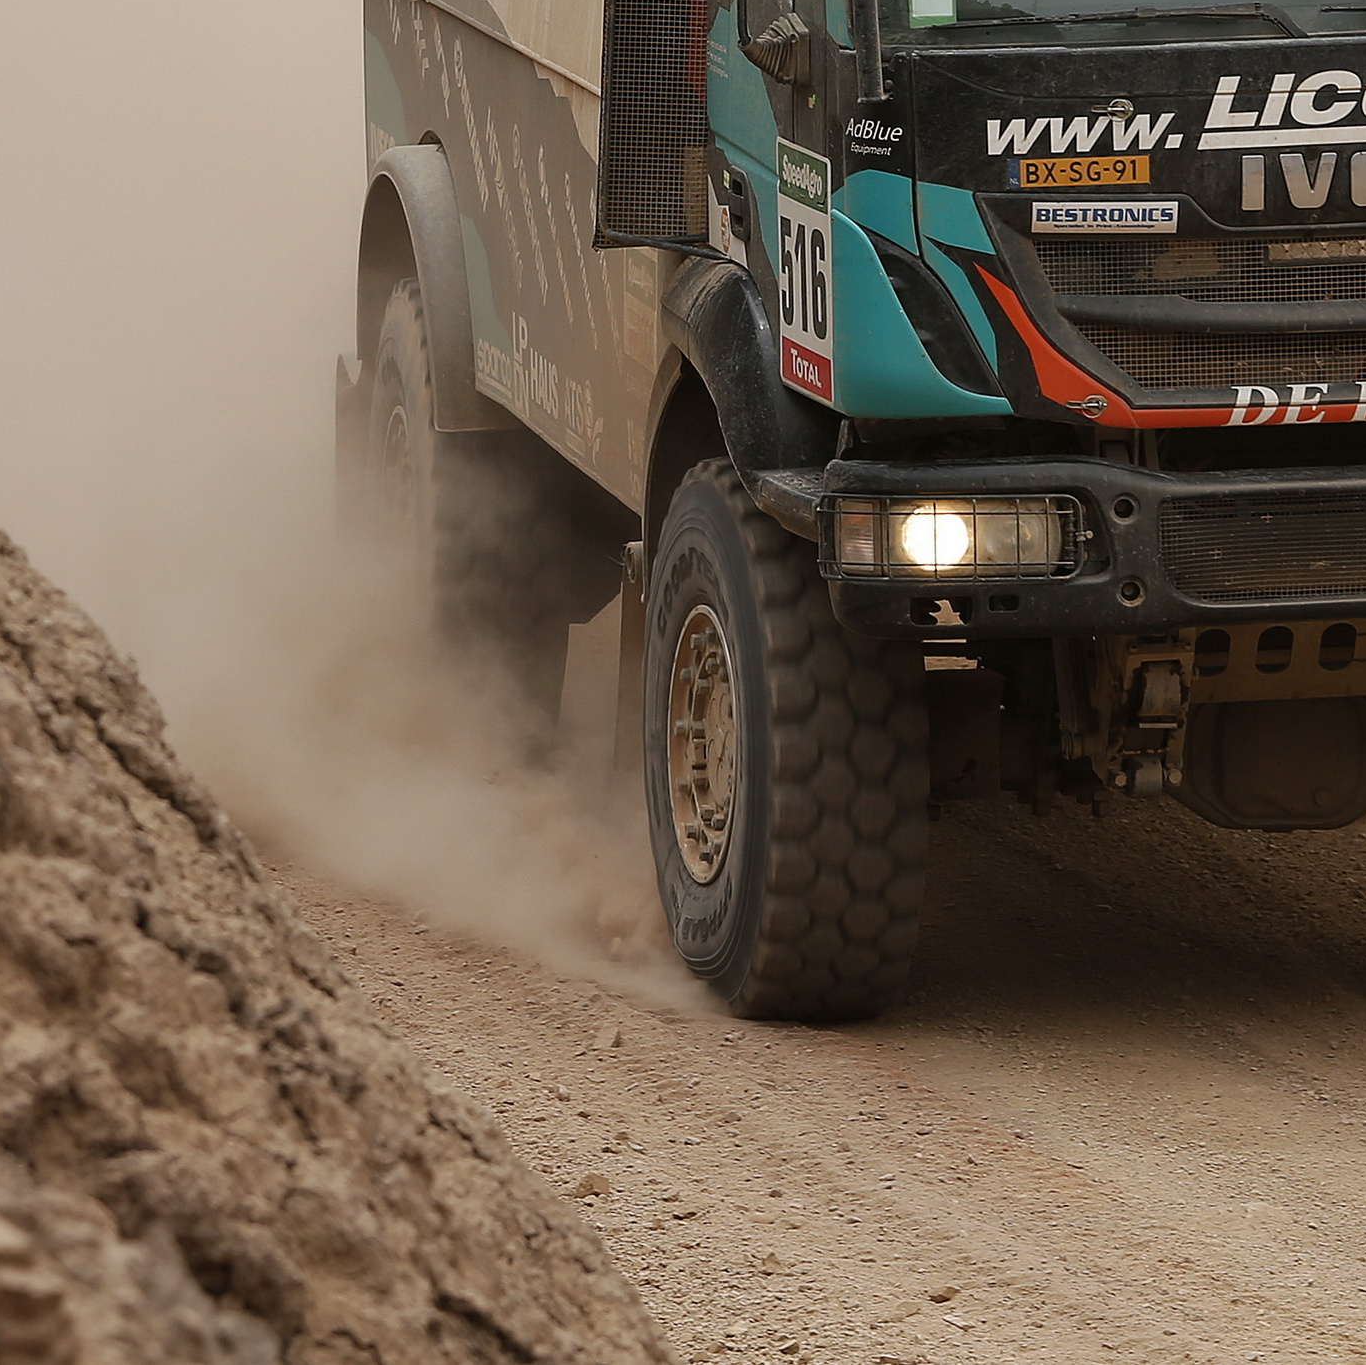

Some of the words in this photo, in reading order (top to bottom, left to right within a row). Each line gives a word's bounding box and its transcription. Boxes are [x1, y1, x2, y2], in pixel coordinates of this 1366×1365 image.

[845, 117, 903, 143] AdBlue
[850, 141, 892, 156] Equipment
[781, 153, 824, 200] SpeedAgro
[1025, 159, 1138, 184] BX-SG-91
[1036, 207, 1174, 222] BESTRONICS
[779, 215, 827, 340] 516
[790, 347, 823, 388] TOTAL
[1223, 382, 1328, 428] DE
